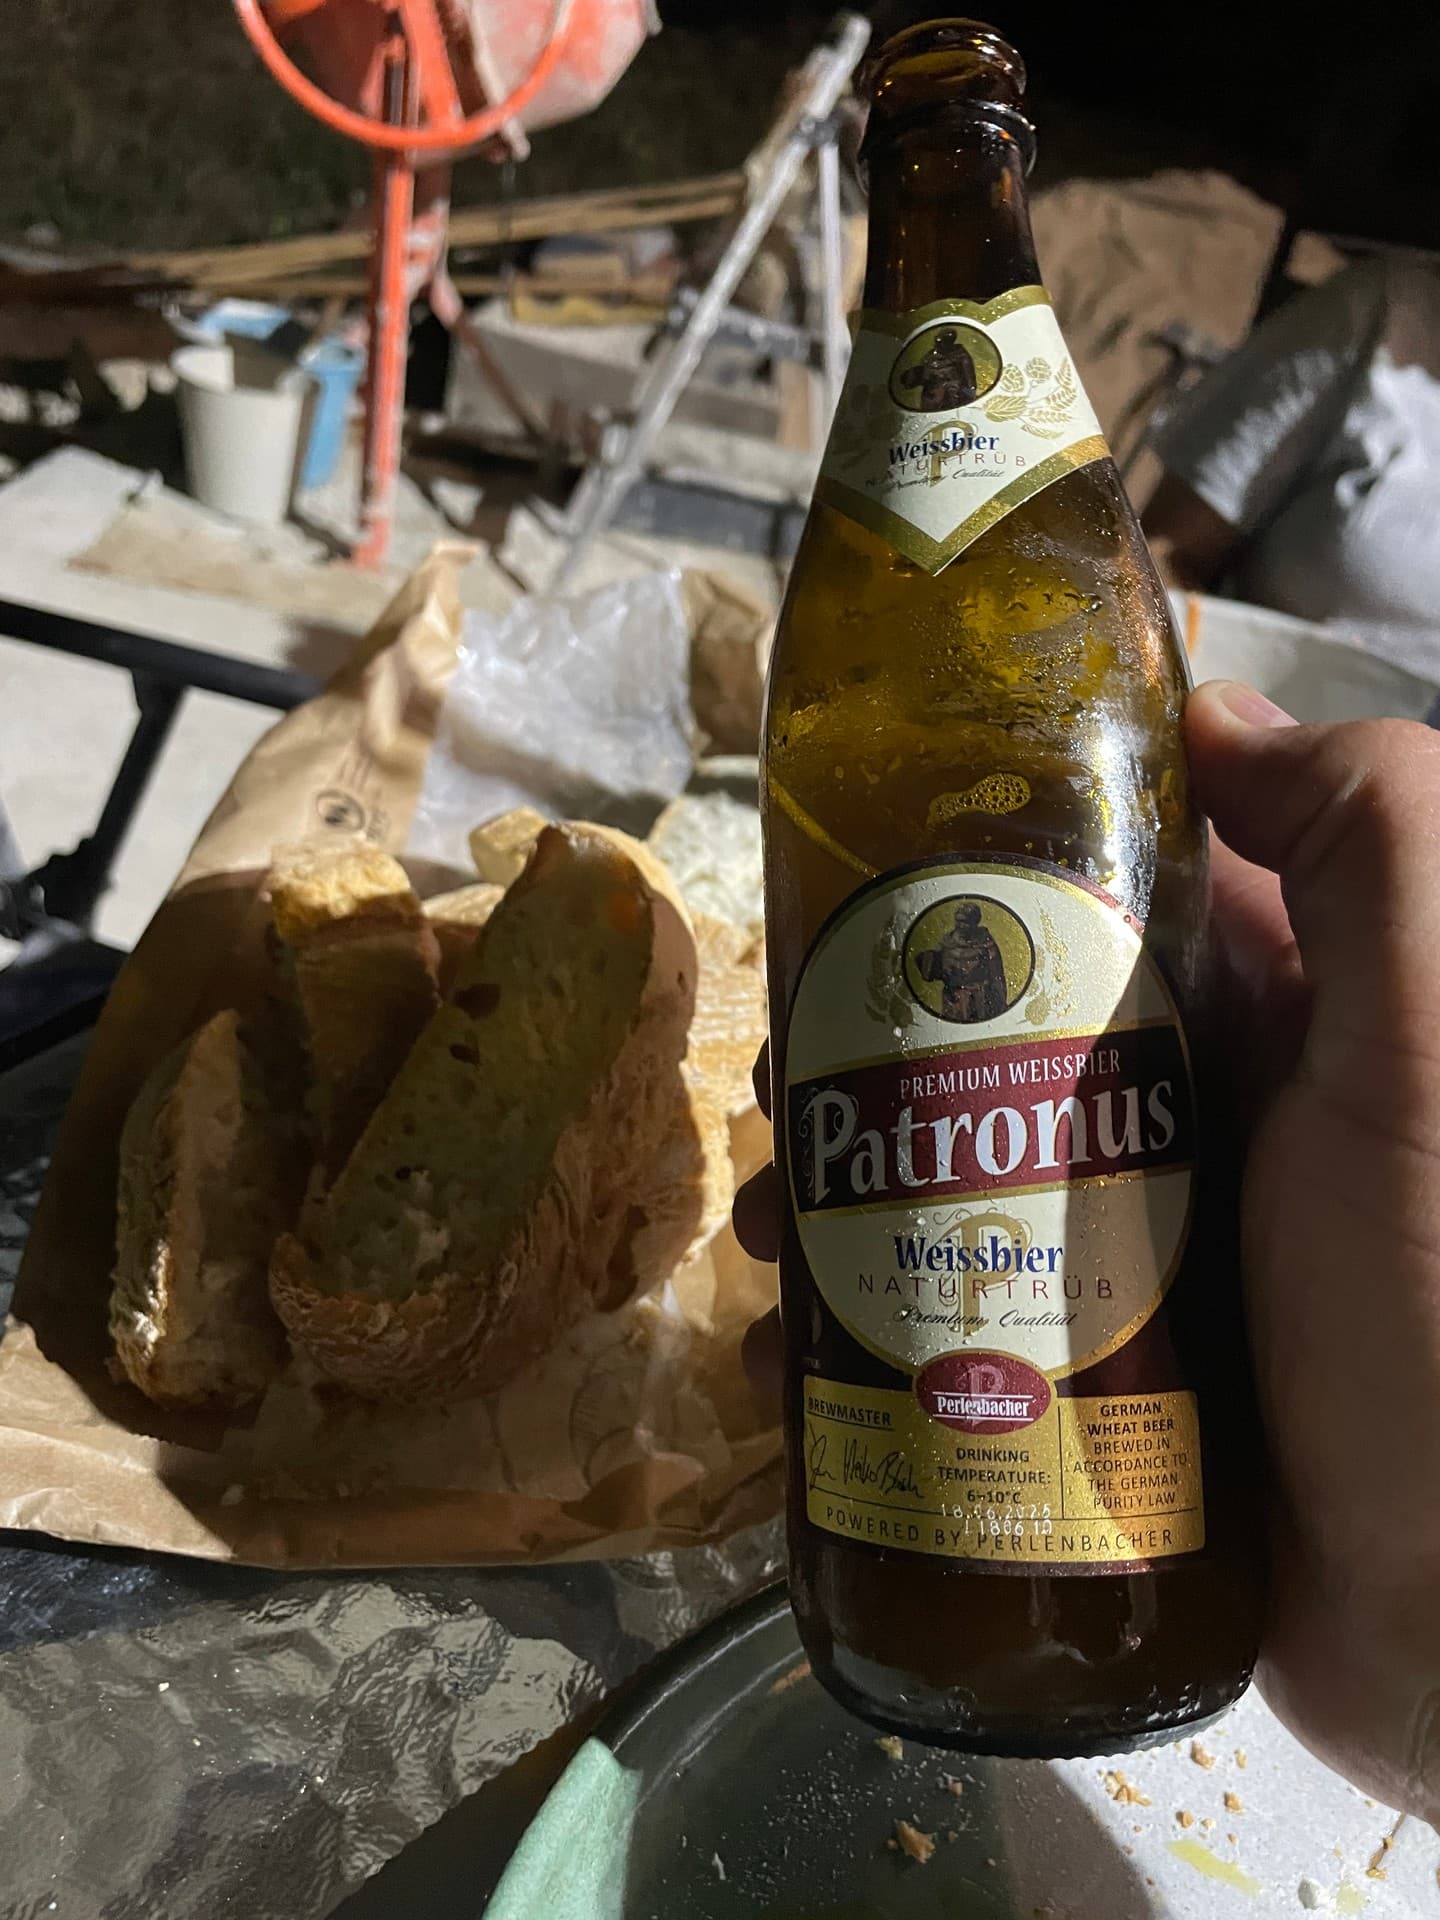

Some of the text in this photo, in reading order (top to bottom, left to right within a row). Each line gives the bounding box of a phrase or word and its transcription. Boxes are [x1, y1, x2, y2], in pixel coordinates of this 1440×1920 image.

[889, 432, 999, 465] Weissbier
[900, 1048, 1121, 1100] PREMIUM WEISSBIER
[803, 1080, 1175, 1205] Patronus
[893, 1235, 1063, 1273] Weissbier
[858, 1273, 1113, 1300] NATURTRÜB
[893, 1305, 1078, 1328] Premium Qualität
[808, 1396, 891, 1426] BREWMASTER
[936, 1395, 1029, 1417] Perlenbacher
[1101, 1401, 1162, 1417] GERMAN
[1087, 1418, 1174, 1437] WHEAT BEER
[956, 1447, 1030, 1463] DRINKING
[1094, 1437, 1171, 1455] BREWED IN
[1073, 1453, 1188, 1473] ACCORDANCE TO
[938, 1466, 1051, 1484] TEMPERATURE:
[1089, 1472, 1178, 1491] THE GERMAN
[1094, 1492, 1176, 1509] PURITY LAW
[827, 1506, 1173, 1552] POWERED BY PERLENBACHER
